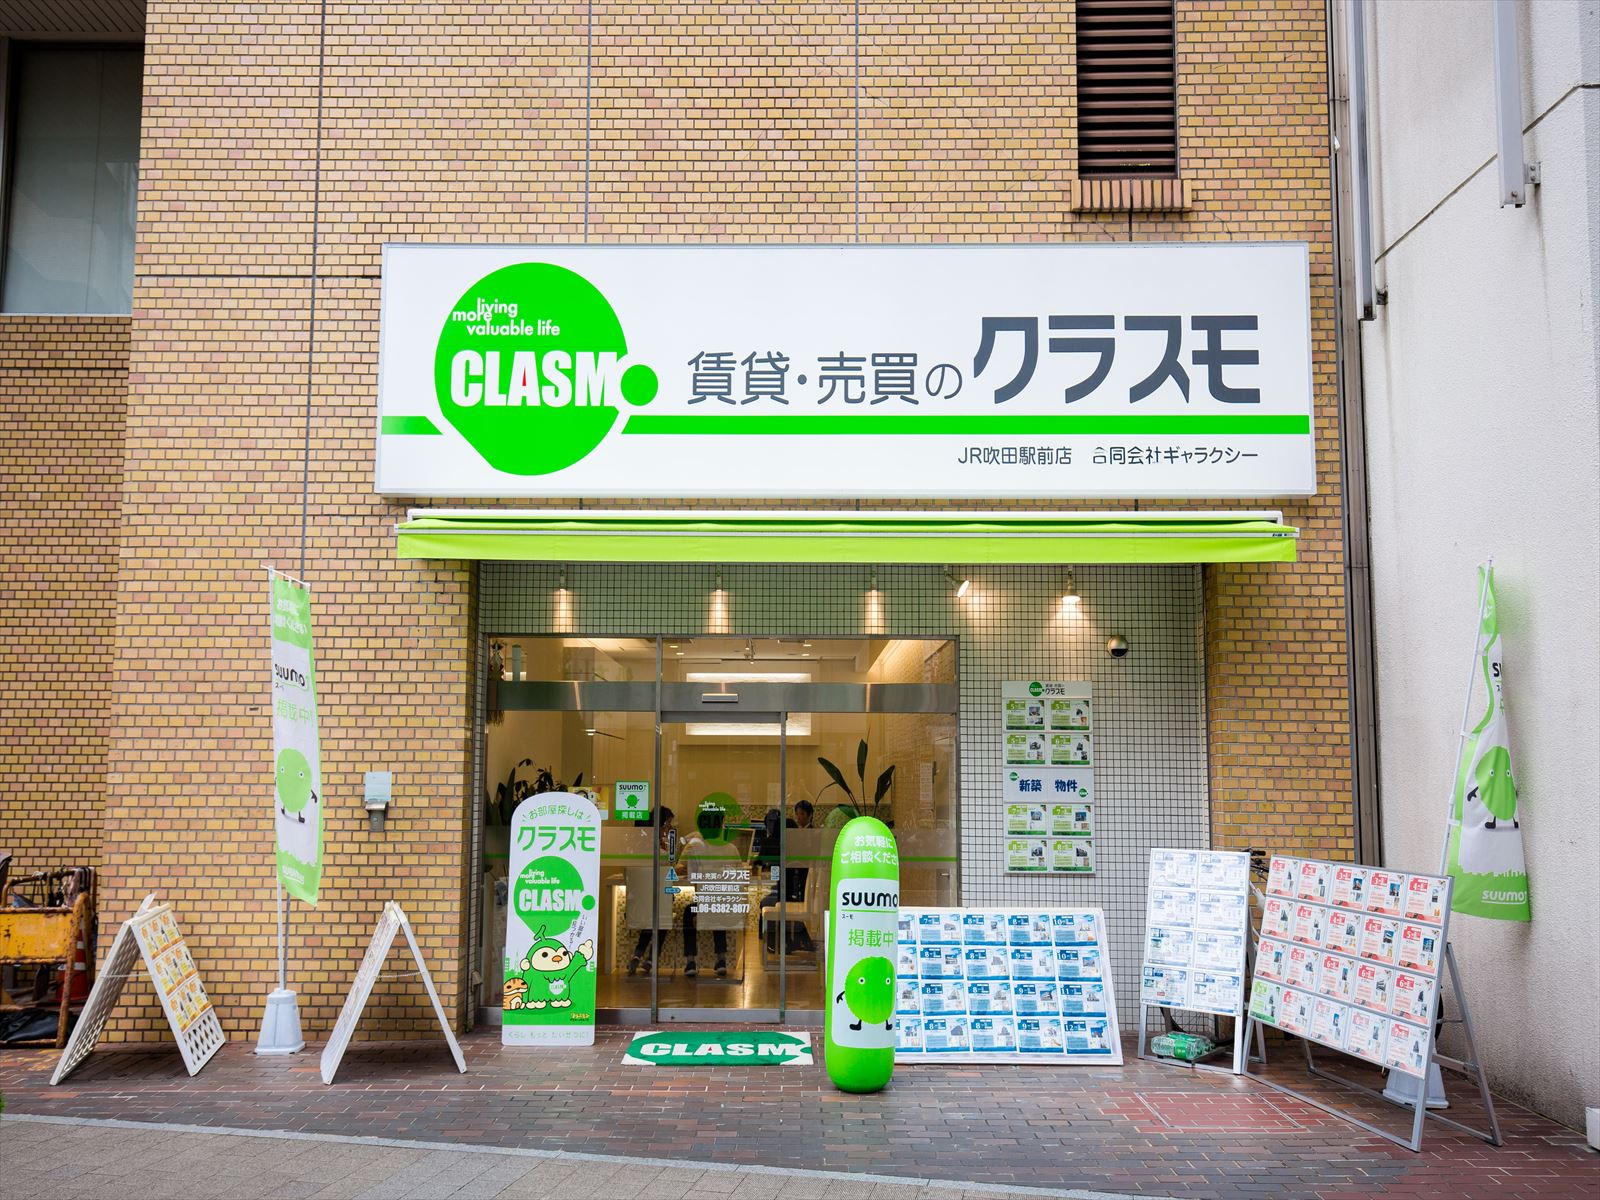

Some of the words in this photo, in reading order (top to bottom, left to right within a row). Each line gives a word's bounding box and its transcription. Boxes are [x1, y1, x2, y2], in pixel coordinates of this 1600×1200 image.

[452, 307, 492, 322] more
[477, 298, 518, 318] living
[466, 319, 534, 336] valuable
[537, 319, 560, 336] life
[957, 446, 1072, 466] JR吹田駅前店
[1092, 446, 1259, 466] 合同会社ギャラクシー
[1019, 779, 1042, 792] 新築
[1054, 779, 1078, 792] 物件
[528, 804, 584, 820] お部屋探しは
[517, 826, 596, 851] クラスモ
[855, 835, 893, 849] お気軽に
